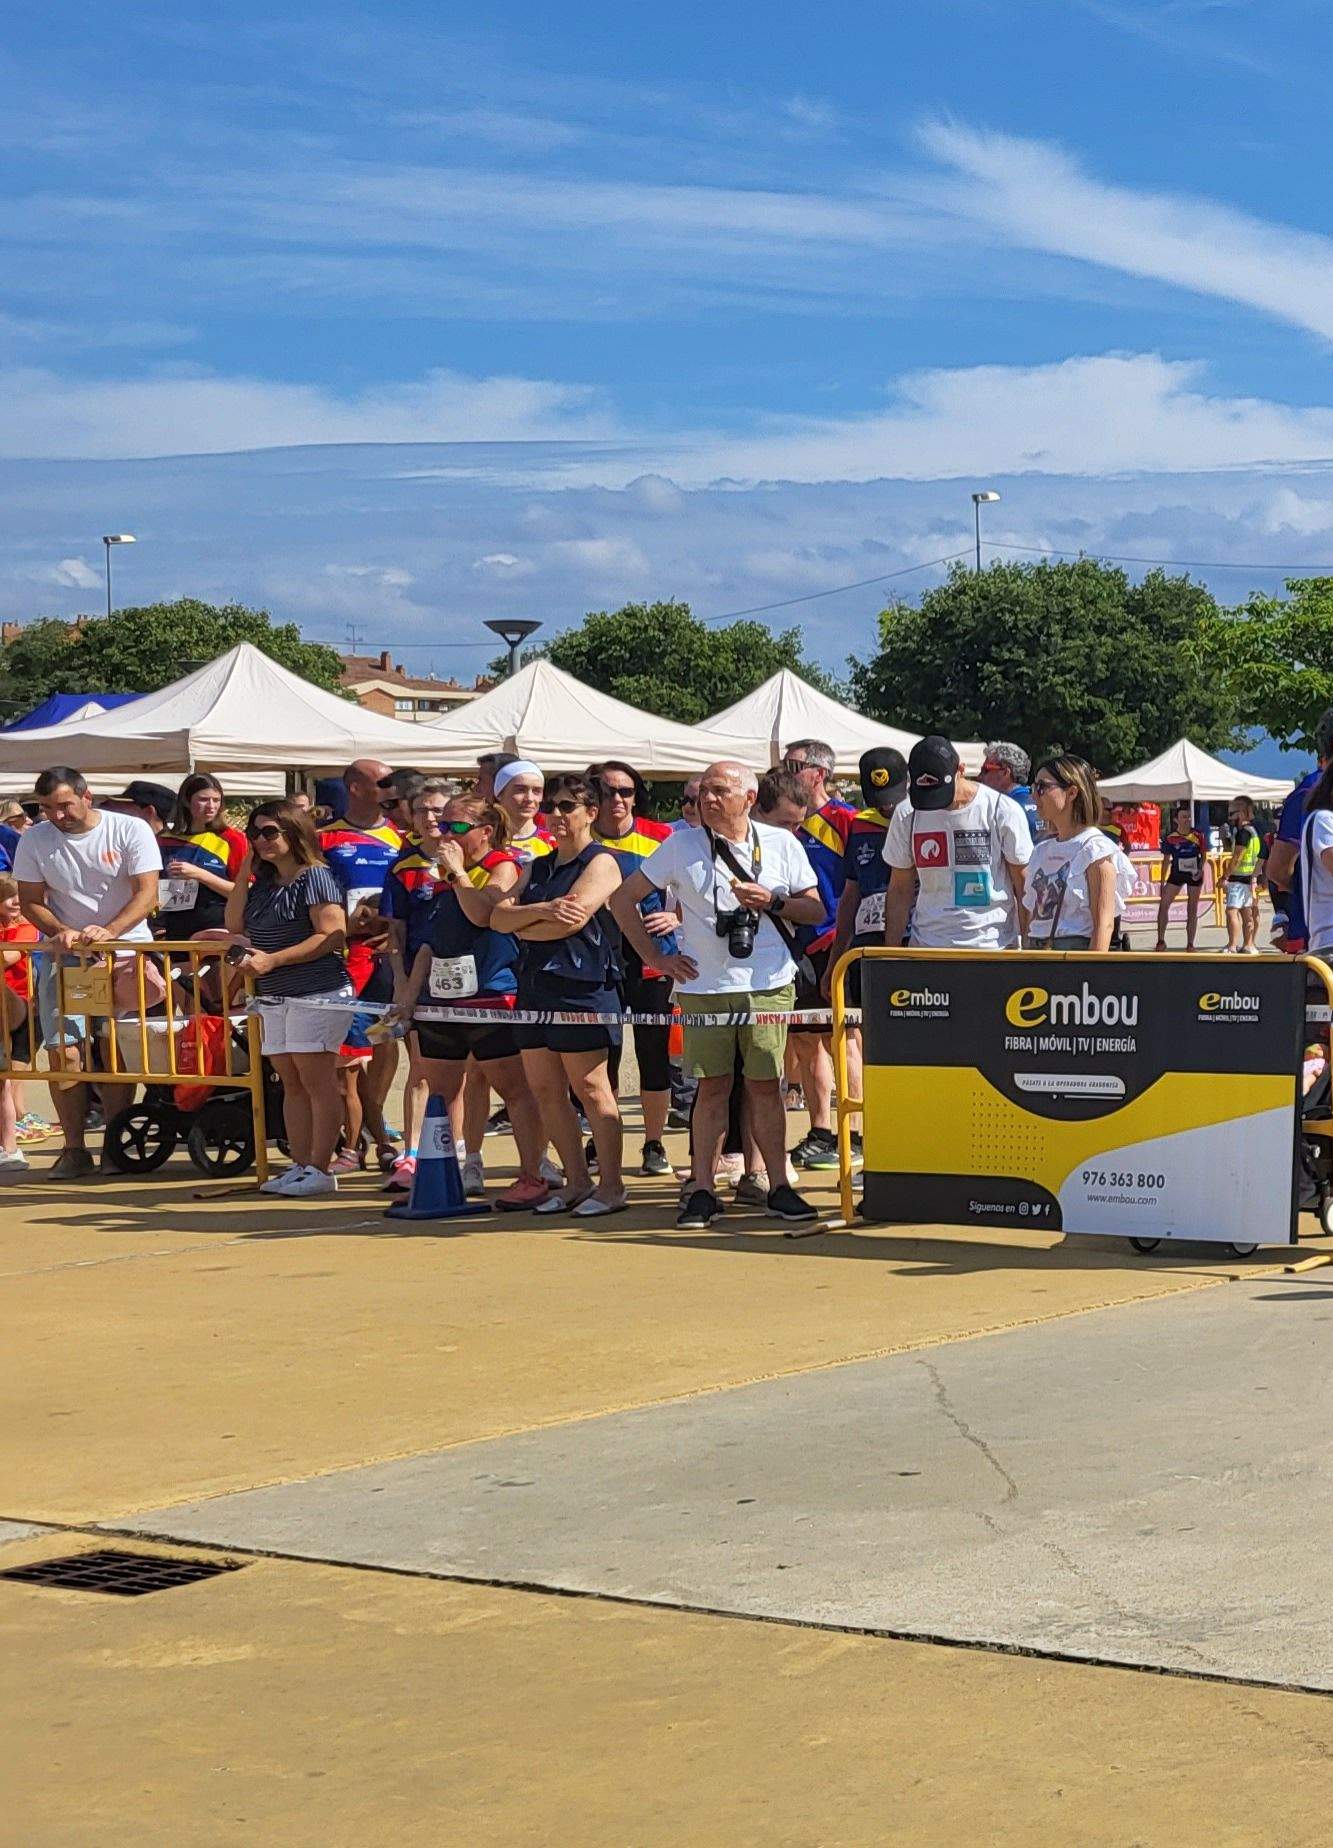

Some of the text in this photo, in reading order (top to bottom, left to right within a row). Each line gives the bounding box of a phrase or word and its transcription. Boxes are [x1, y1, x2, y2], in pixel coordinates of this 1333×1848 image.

[436, 977, 464, 990] 463
[890, 988, 950, 1007] embou
[1005, 981, 1138, 1028] embou
[1199, 991, 1260, 1011] embou
[789, 1013, 803, 1024] NO
[1005, 1034, 1136, 1052] FIBRA MÓVIL TV ENERGÍA
[1082, 1171, 1165, 1189] 976 363 800
[969, 1201, 1015, 1214] Síguenos en
[1088, 1193, 1157, 1206] www.embou.com
